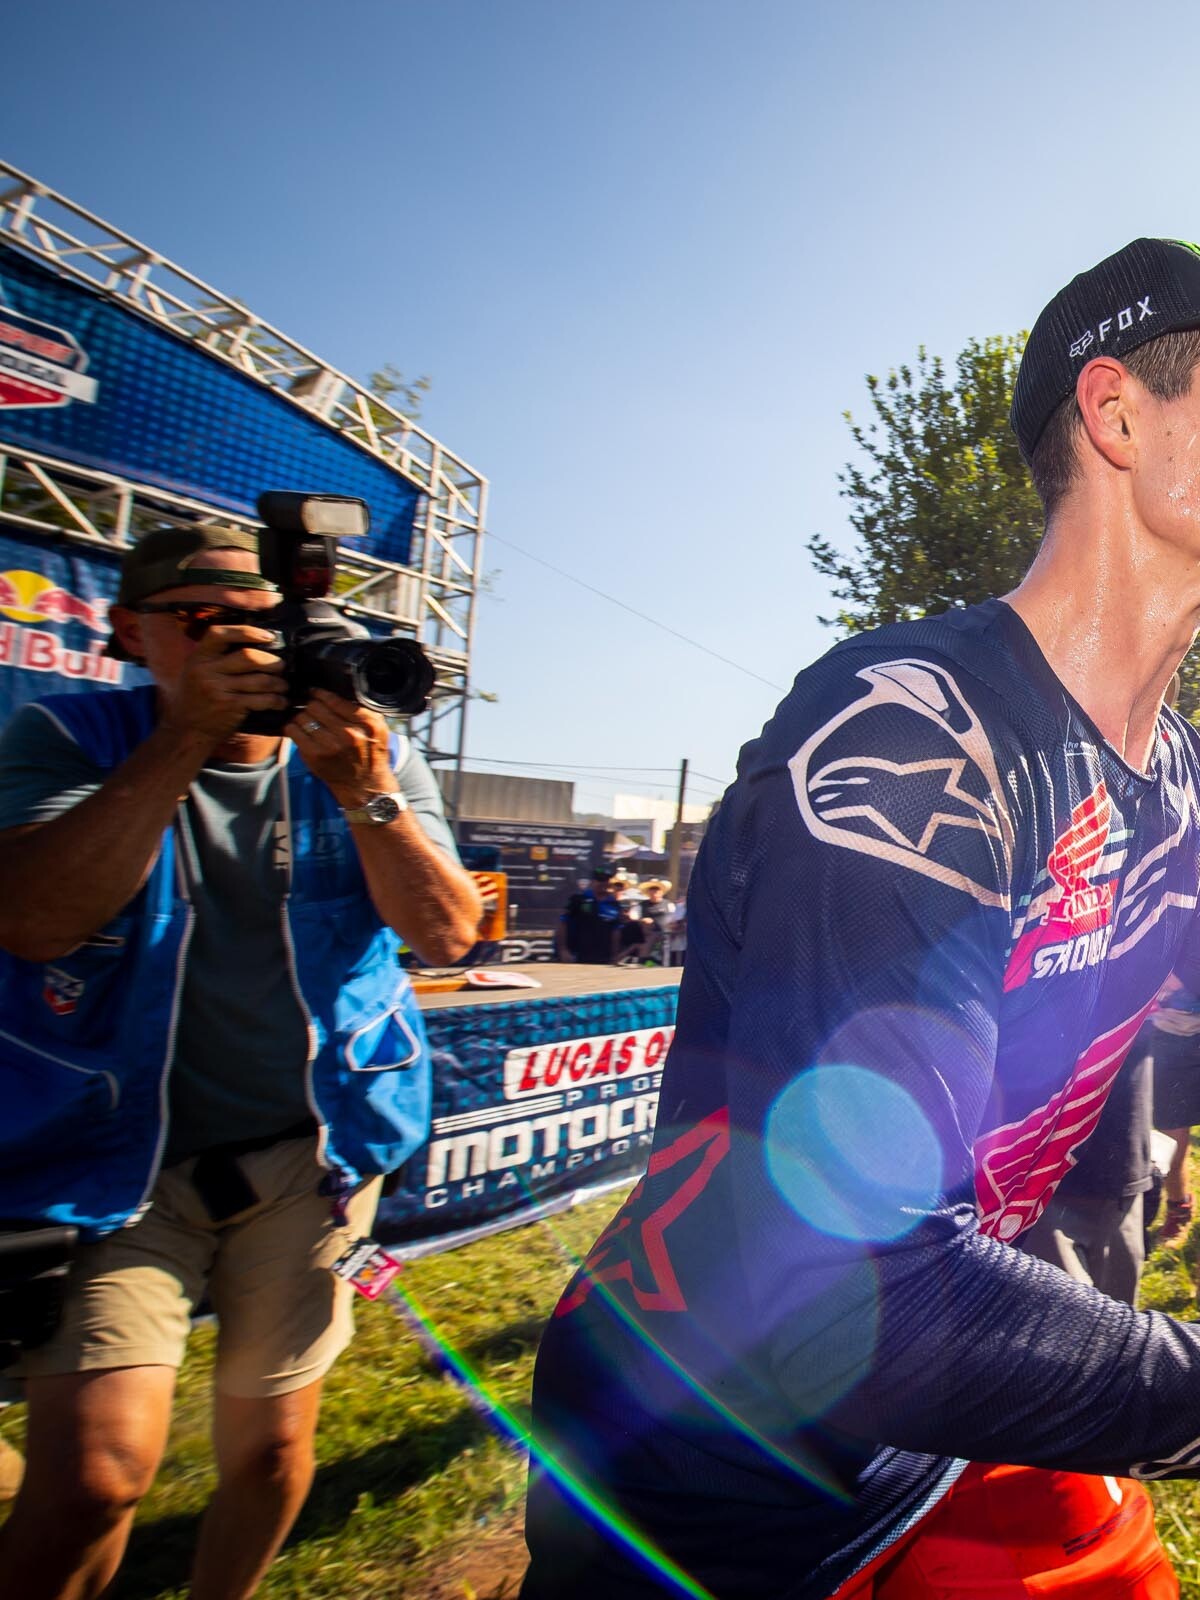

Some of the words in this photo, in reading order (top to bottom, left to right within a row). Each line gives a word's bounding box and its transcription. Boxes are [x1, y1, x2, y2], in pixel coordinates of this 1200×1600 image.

[1099, 295, 1152, 342] FOX
[518, 1035, 637, 1092] LUCAS
[565, 1076, 650, 1107] PRO
